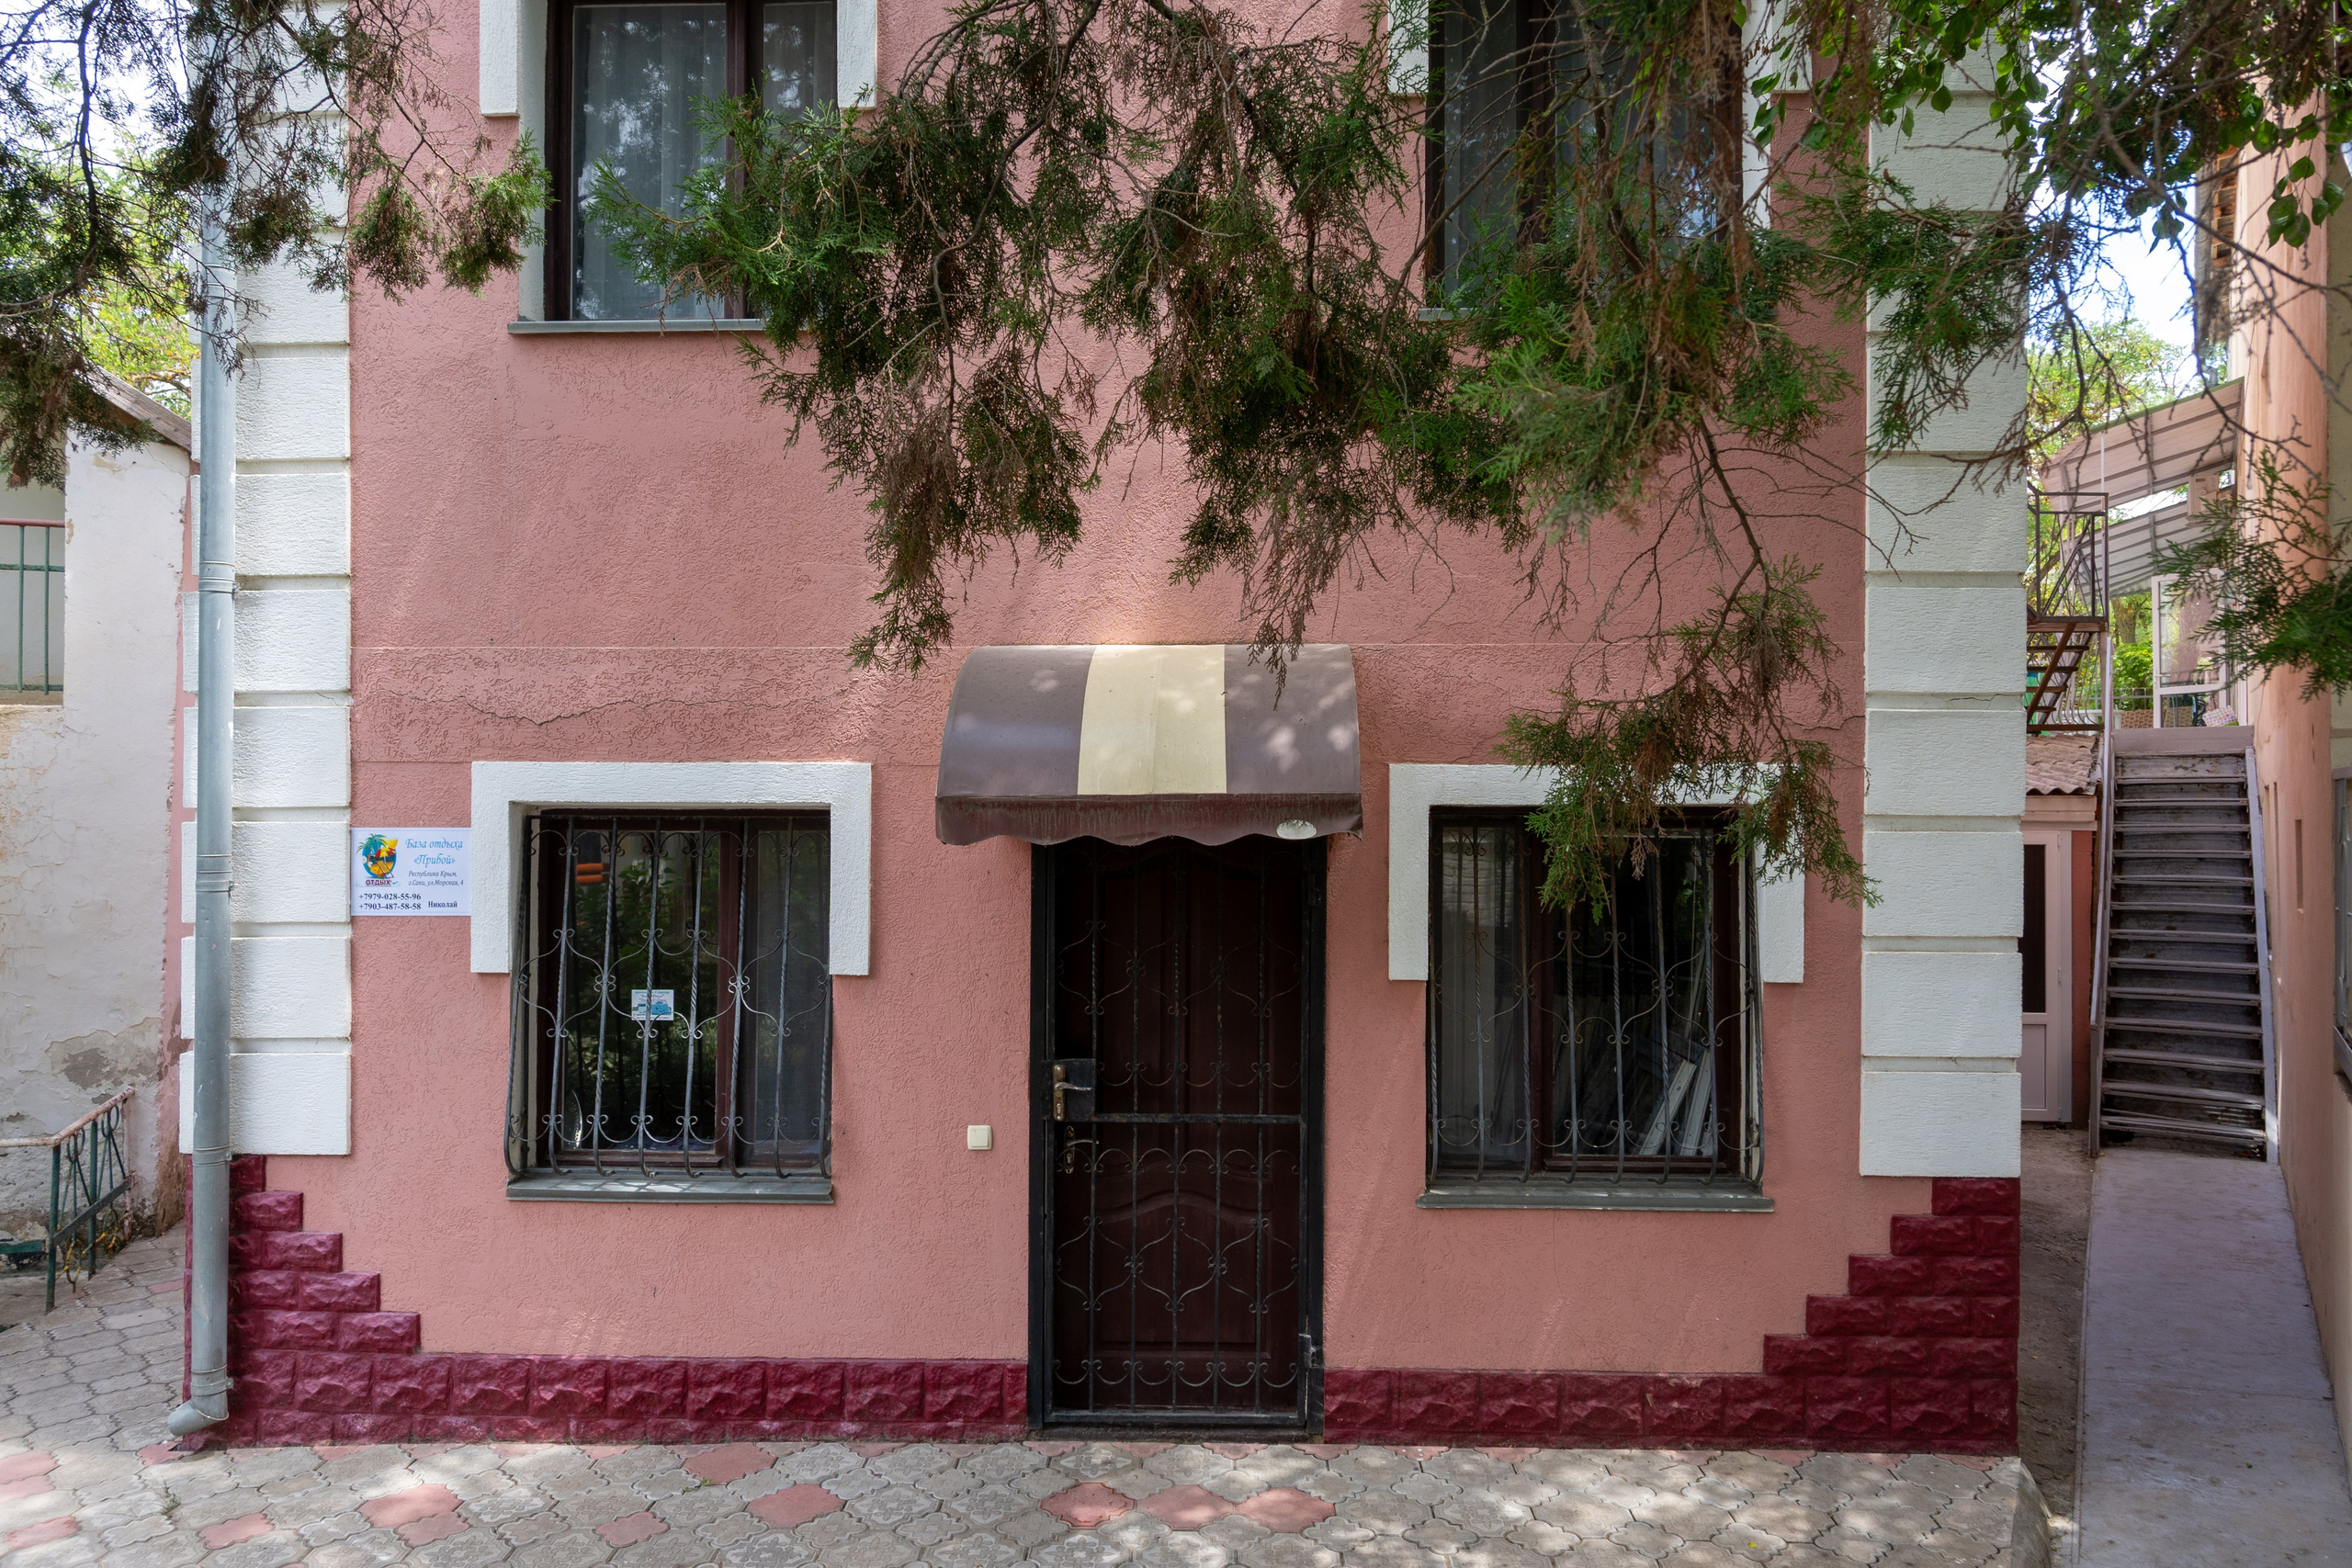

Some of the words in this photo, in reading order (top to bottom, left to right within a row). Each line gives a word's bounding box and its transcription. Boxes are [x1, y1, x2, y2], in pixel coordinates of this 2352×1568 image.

[405, 838, 427, 849] База
[429, 837, 463, 851] отдыха
[408, 870, 439, 878] Республика
[358, 893, 422, 901] +7979-028-55-96
[358, 903, 422, 911] +7903-487-58-58
[427, 900, 458, 908] Николай
